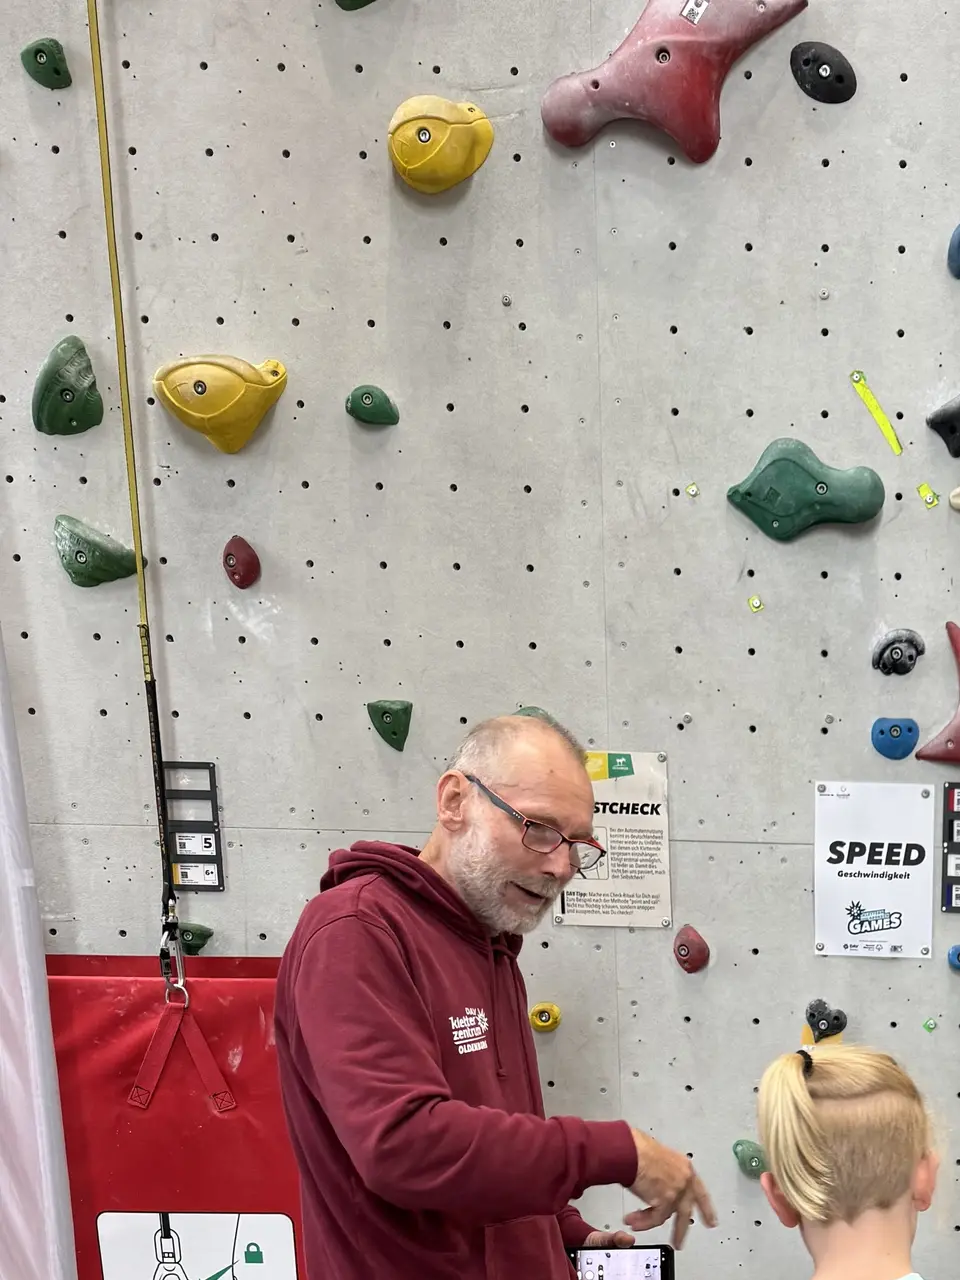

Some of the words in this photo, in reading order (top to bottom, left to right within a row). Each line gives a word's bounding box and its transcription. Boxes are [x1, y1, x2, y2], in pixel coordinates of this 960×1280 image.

[593, 802, 662, 816] STCHECK
[204, 838, 212, 848] 5
[827, 841, 926, 866] SPEED
[838, 870, 910, 881] Geschwindigkeit
[848, 912, 902, 935] GAMES
[449, 1015, 477, 1029] kletter
